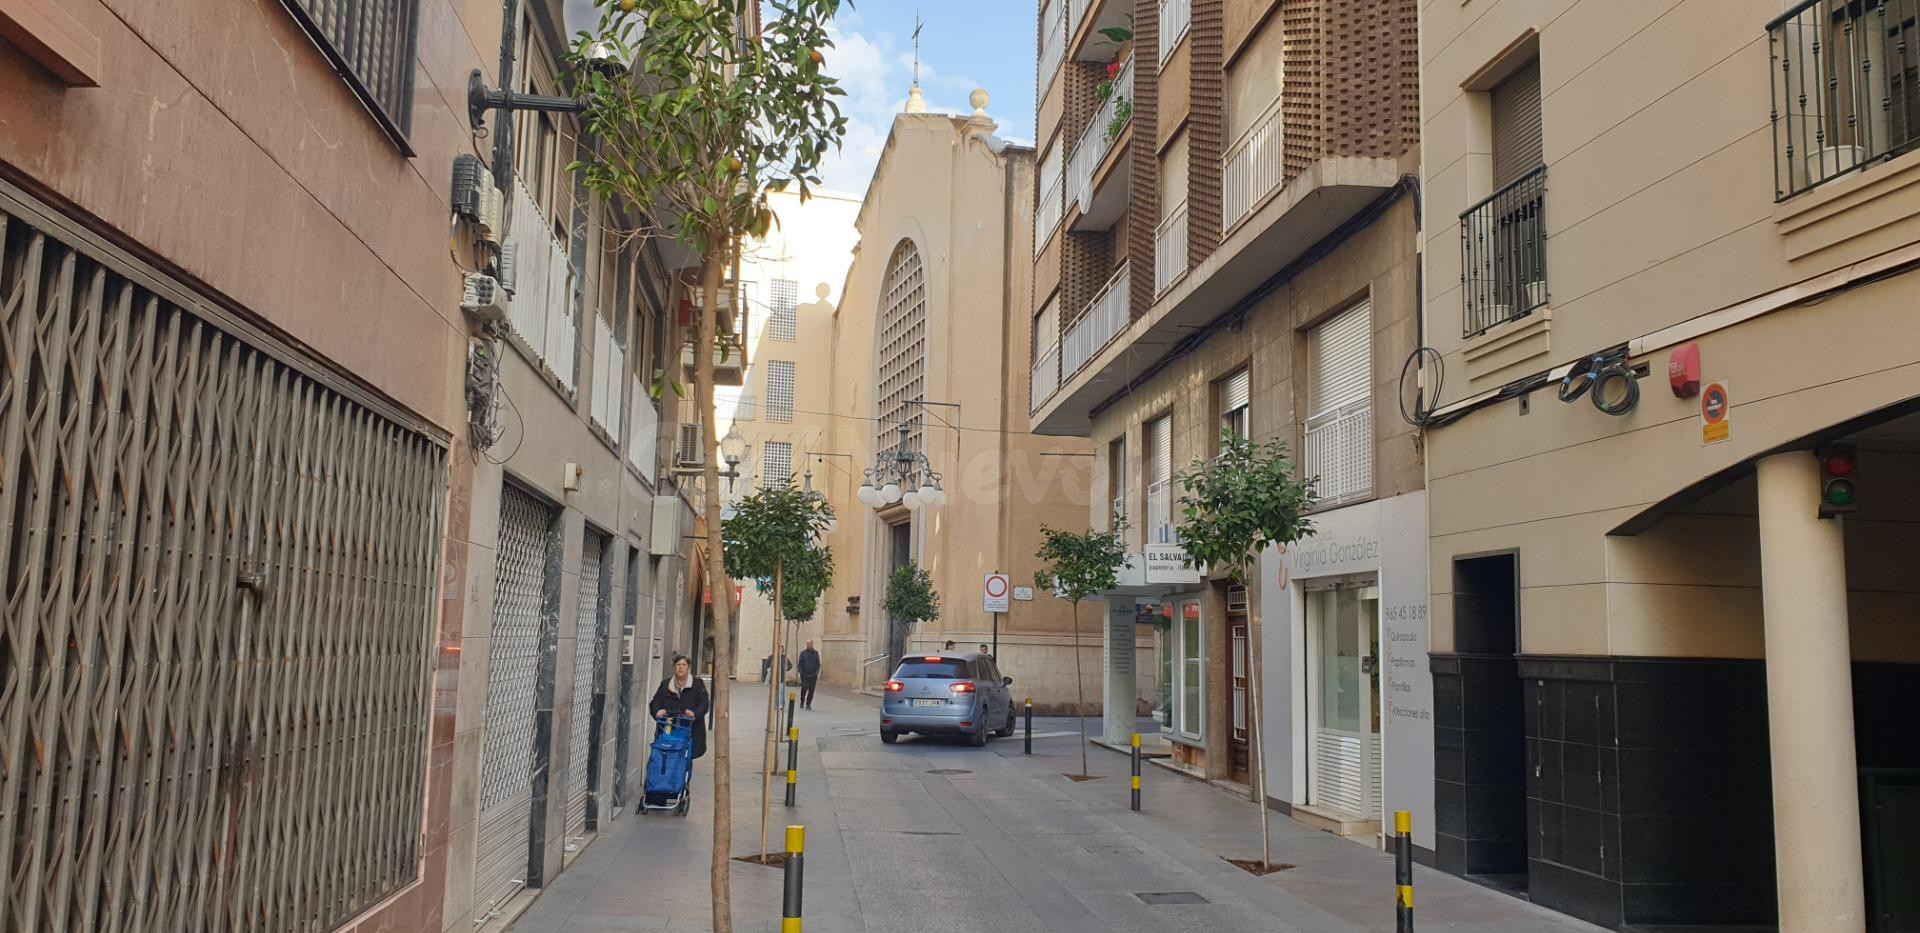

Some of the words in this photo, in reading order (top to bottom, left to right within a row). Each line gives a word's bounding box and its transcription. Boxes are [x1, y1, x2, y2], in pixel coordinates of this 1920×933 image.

[1149, 552, 1158, 561] EL
[1292, 544, 1327, 572] Virginia
[1329, 536, 1379, 564] González
[1385, 606, 1398, 621] 965
[1399, 605, 1407, 621] 45
[1409, 605, 1417, 620] 18
[1418, 603, 1427, 620] 89
